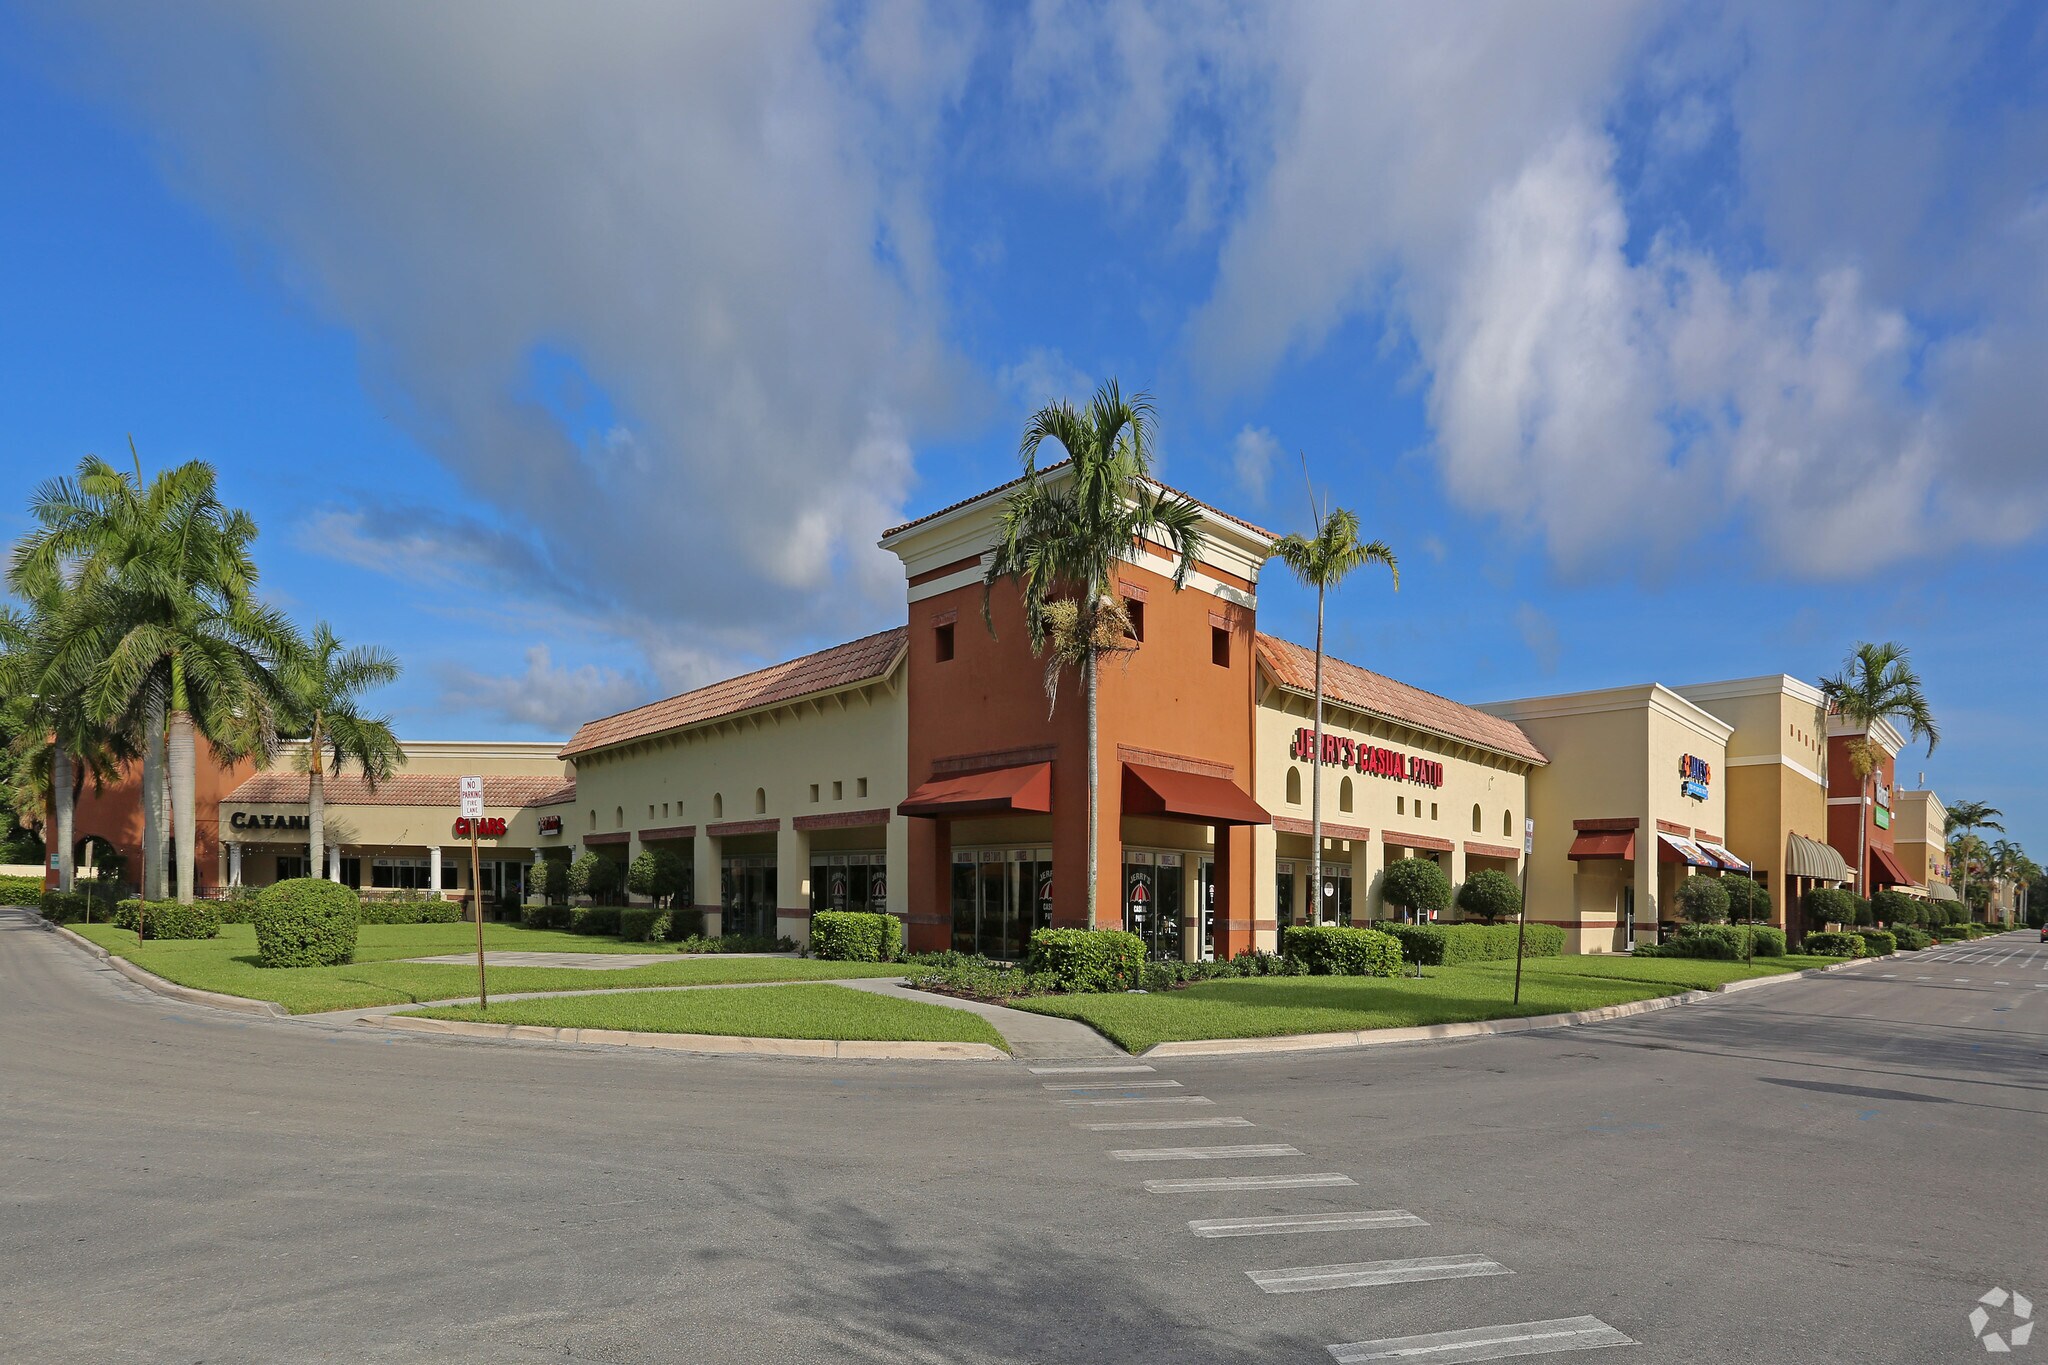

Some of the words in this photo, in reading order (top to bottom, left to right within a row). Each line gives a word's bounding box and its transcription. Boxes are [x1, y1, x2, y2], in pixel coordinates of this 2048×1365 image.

[1295, 727, 1355, 766] JERY'S
[1360, 743, 1409, 779] CASUAL
[1413, 756, 1443, 788] PATIO
[467, 781, 476, 789] NO
[463, 791, 482, 799] PARKING
[230, 812, 325, 830] CATANI
[1130, 872, 1152, 885] JERRY'S
